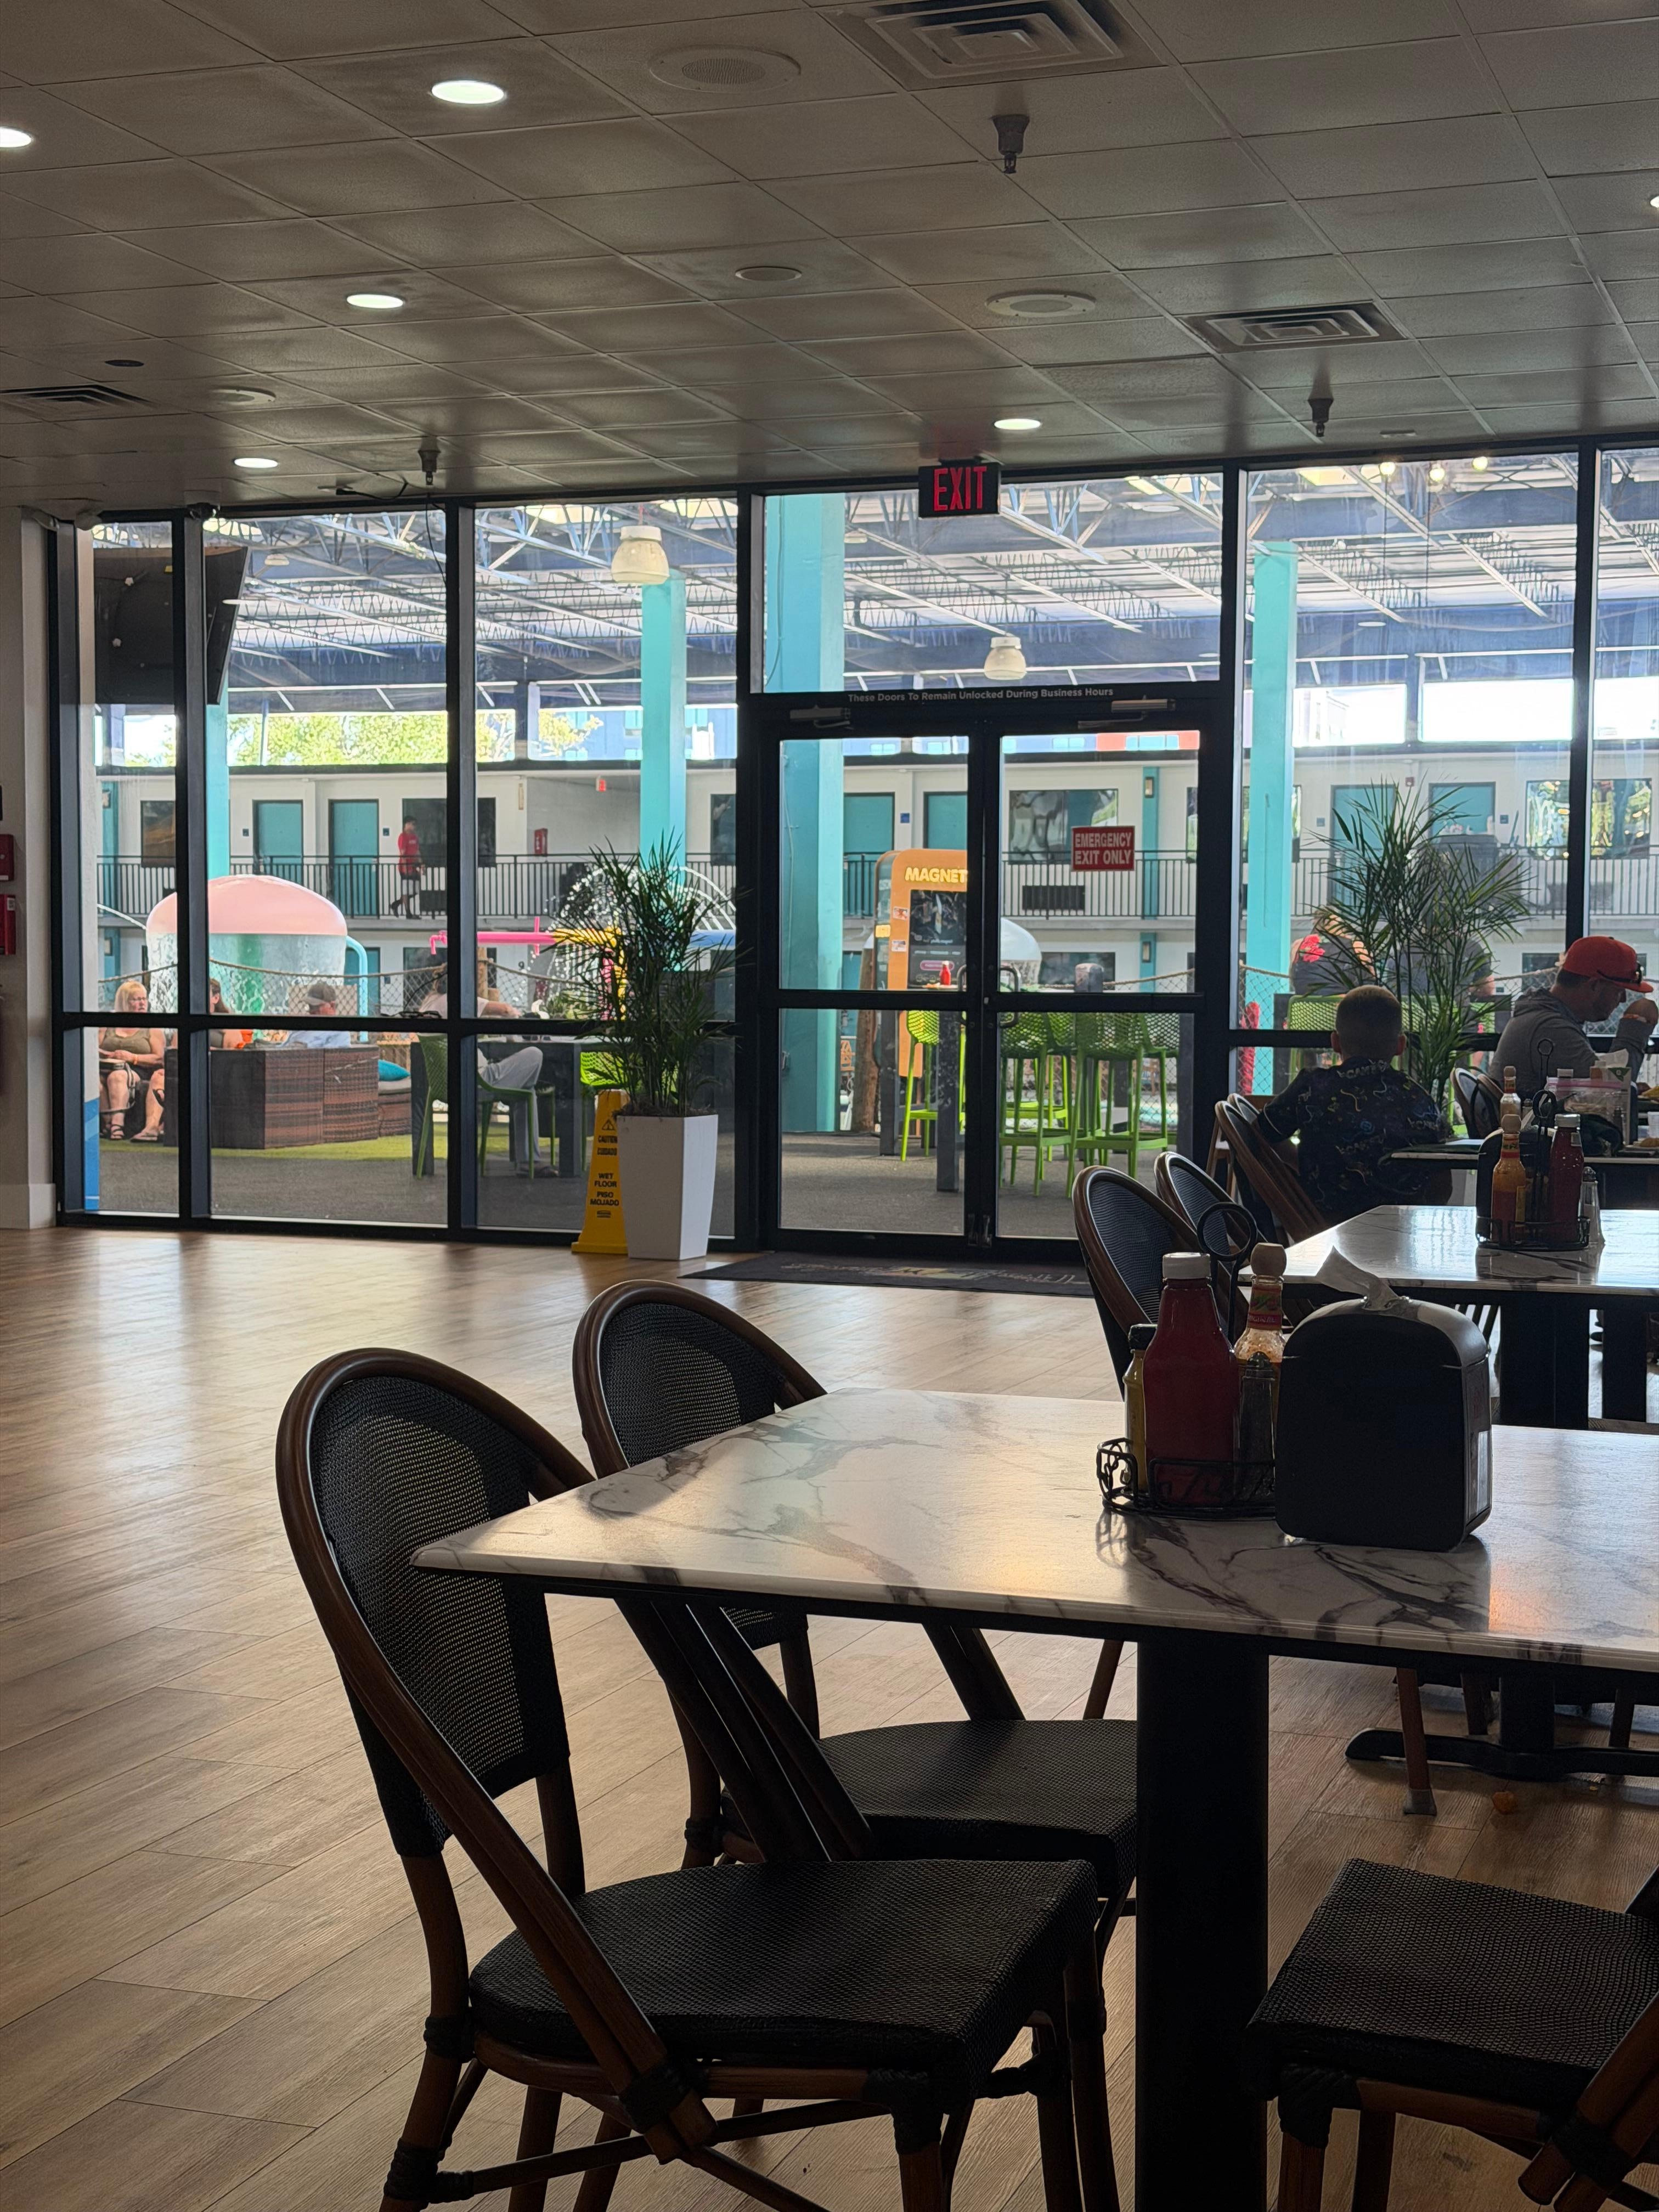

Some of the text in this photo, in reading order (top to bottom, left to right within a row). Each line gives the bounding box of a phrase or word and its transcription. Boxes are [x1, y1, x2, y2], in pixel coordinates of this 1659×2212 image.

[934, 466, 987, 511] EXIT
[908, 692, 919, 701] To
[922, 692, 957, 700] Remain
[960, 690, 1003, 699] Unlocked
[1006, 690, 1038, 699] During
[1041, 689, 1082, 697] Business
[1085, 688, 1113, 696] Hours
[1075, 832, 1131, 848] EMERGENCY
[1075, 850, 1131, 865] EXIT ONLY
[905, 867, 968, 883] MAGNET
